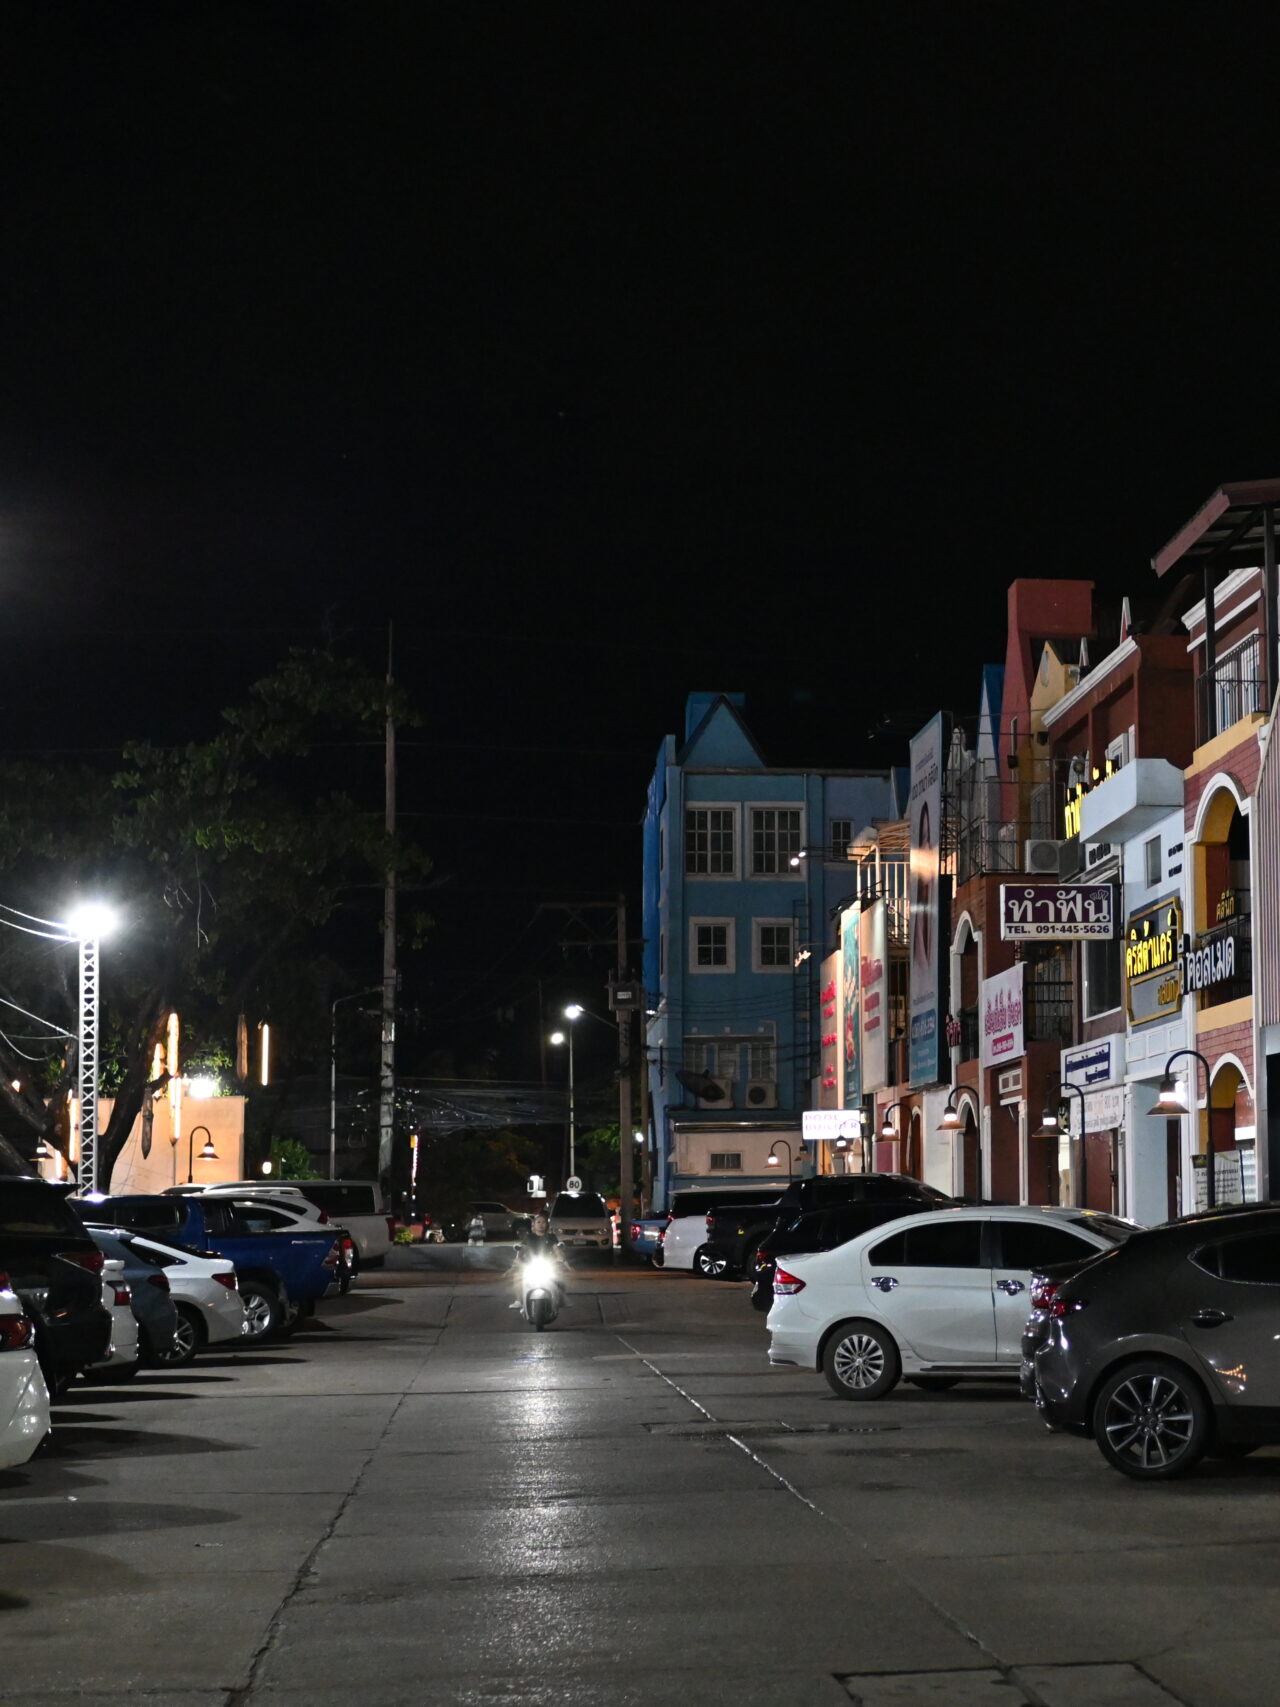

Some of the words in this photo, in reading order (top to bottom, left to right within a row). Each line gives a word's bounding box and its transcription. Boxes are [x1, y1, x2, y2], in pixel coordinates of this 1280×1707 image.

[1008, 889, 1110, 922] ทำฟัน
[1007, 925, 1031, 934] TEL.
[1035, 925, 1110, 934] 091-445-5626
[569, 1180, 580, 1189] 80
